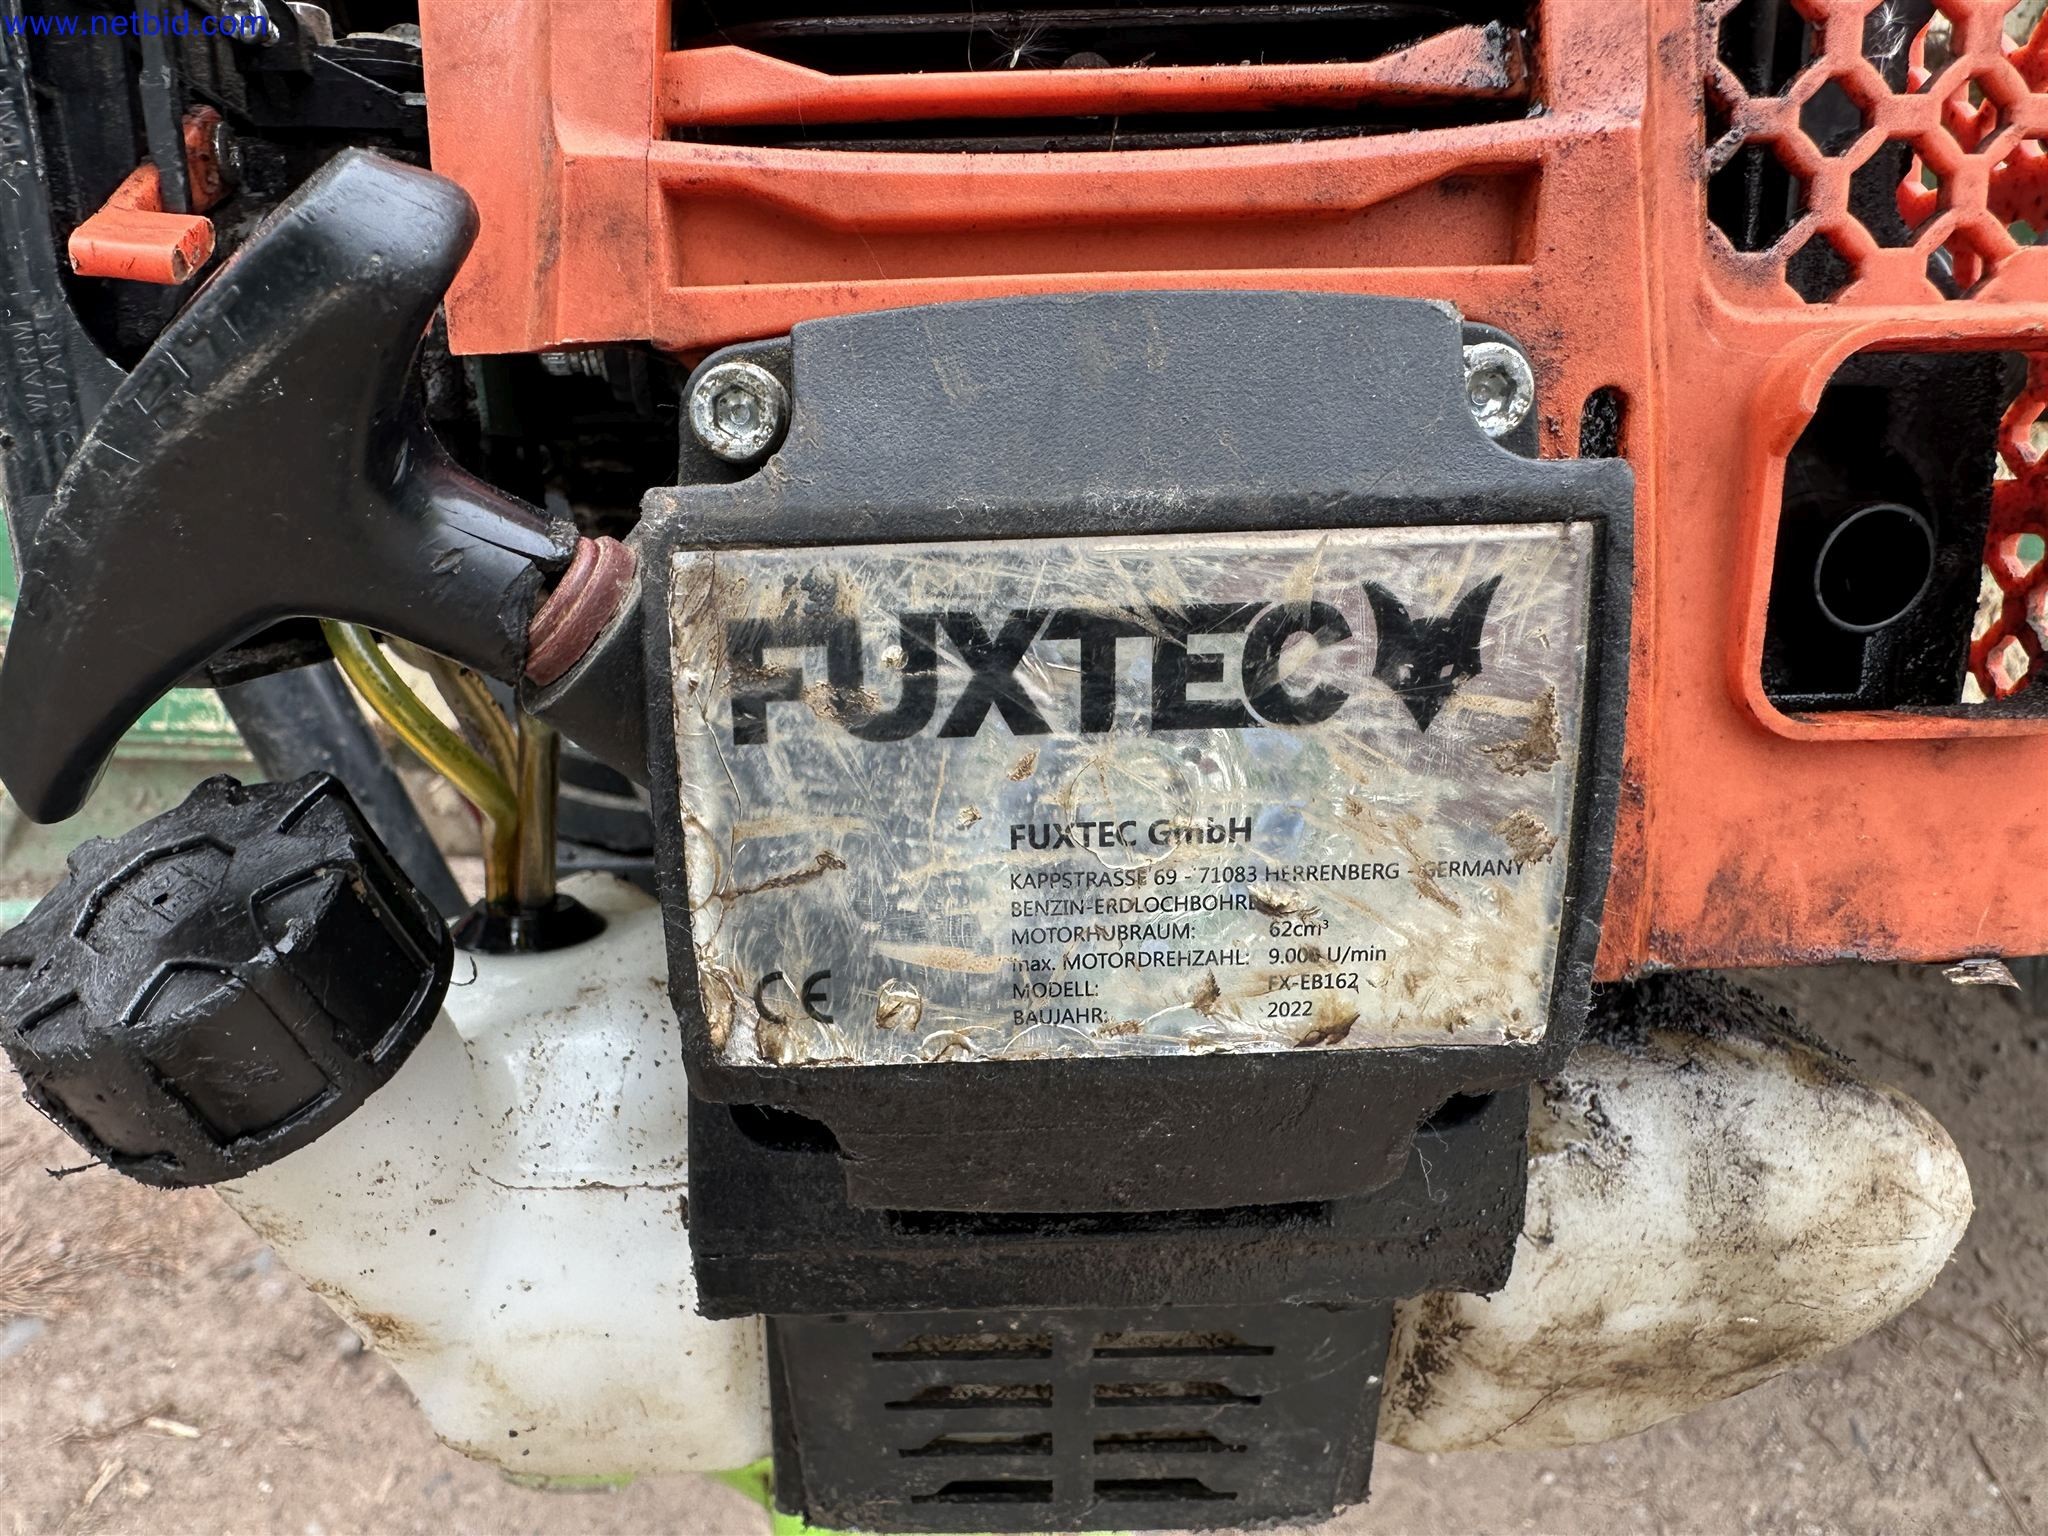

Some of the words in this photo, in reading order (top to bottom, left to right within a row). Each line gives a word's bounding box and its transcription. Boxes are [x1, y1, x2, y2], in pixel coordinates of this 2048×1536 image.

[9, 320, 49, 414] WARM
[729, 602, 1353, 745] FUXTEC
[1010, 820, 1137, 850] FUXTEC
[1148, 816, 1252, 846] GmbH
[1010, 868, 1147, 890] KAPPSTRASSE
[1153, 869, 1177, 885] 69
[1200, 865, 1258, 884] 71083
[1264, 861, 1400, 883] HERRENBERG
[1424, 859, 1524, 879] GERMANY
[1011, 923, 1195, 945] MOTORHUBRAUM:
[1012, 958, 1056, 972] max.
[1063, 950, 1250, 970] MOTORDREHZAHL:
[1327, 945, 1387, 965] U/min
[1013, 980, 1099, 999] MODELL:
[1268, 972, 1359, 992] FX-EB162
[1014, 1008, 1108, 1026] BAUJAHR:
[1267, 1001, 1313, 1018] 2022
